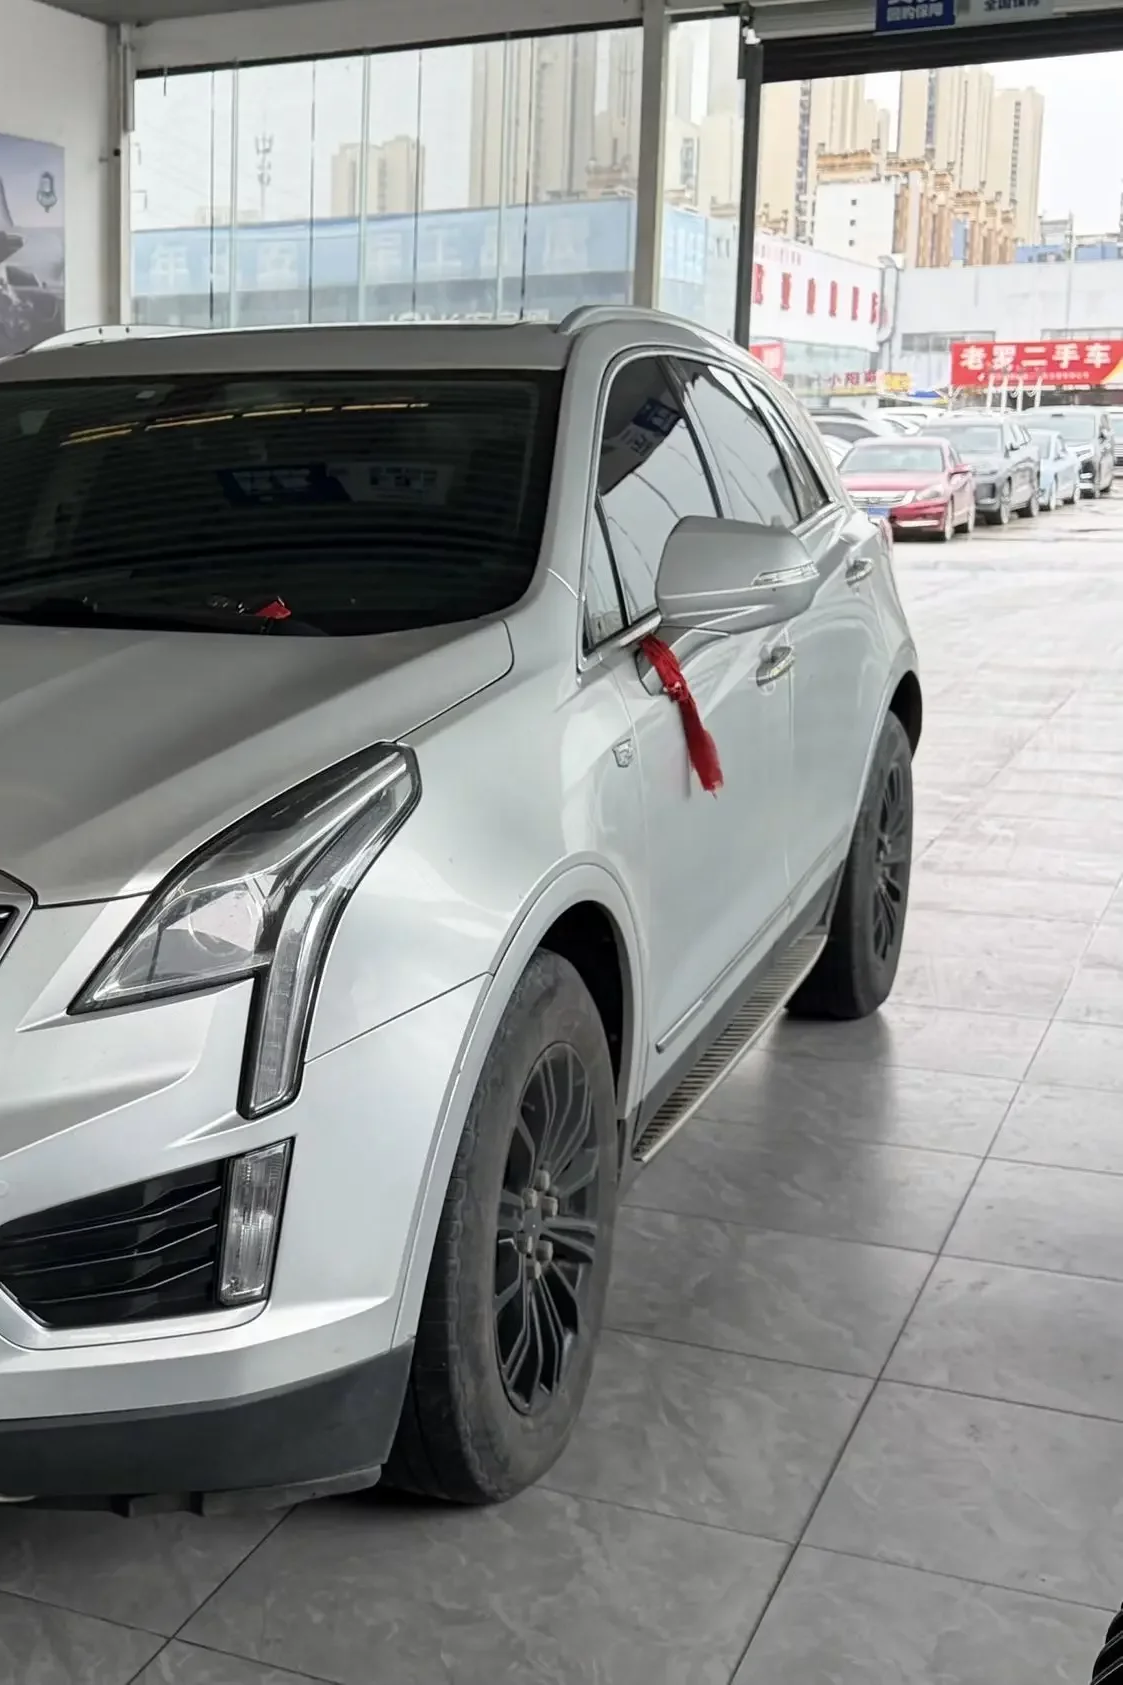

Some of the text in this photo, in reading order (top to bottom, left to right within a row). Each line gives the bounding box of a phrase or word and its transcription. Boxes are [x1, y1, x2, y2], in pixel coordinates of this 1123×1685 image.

[959, 342, 1112, 371] 老罗二手车
